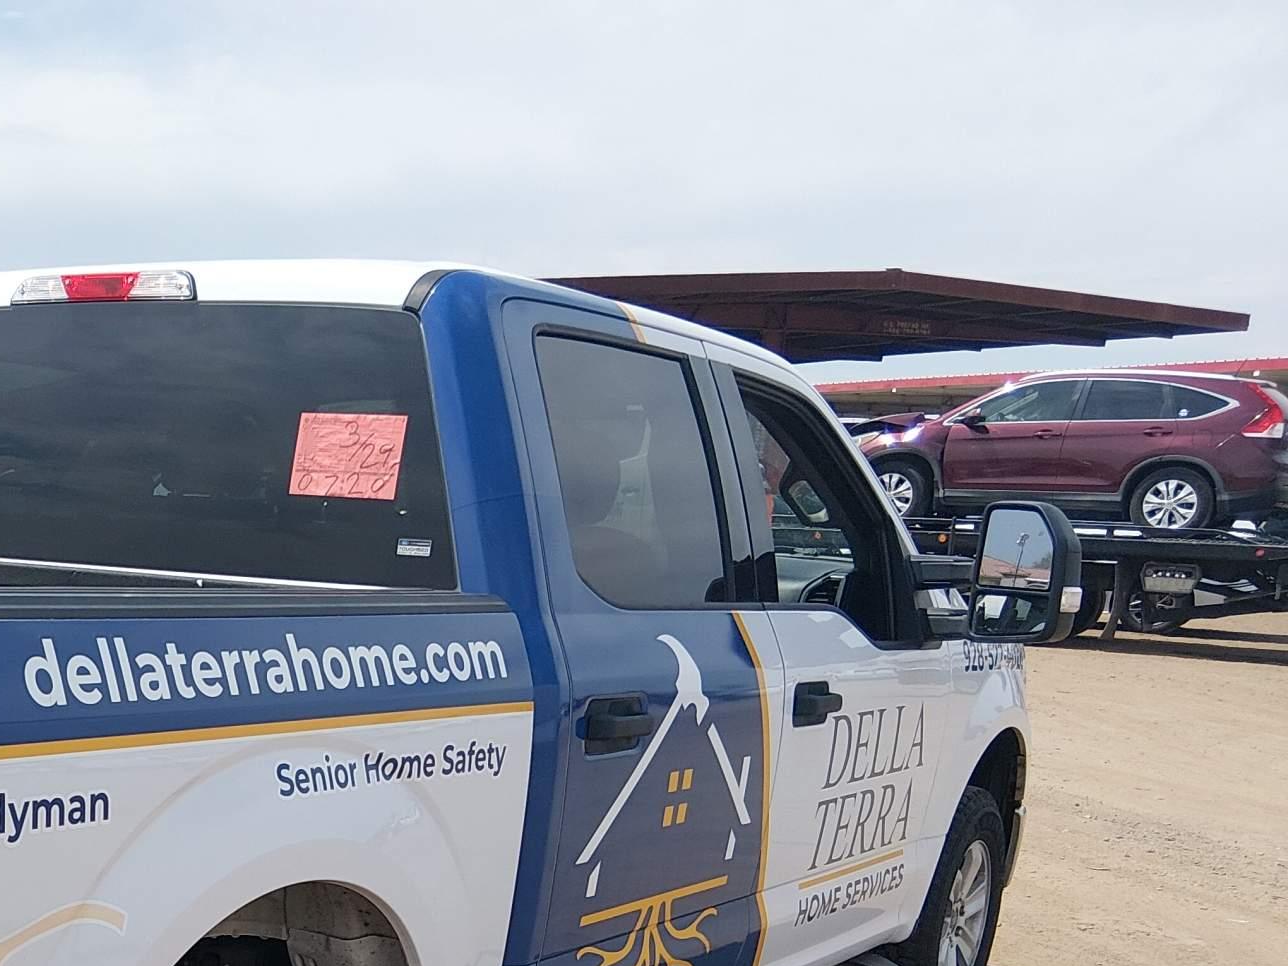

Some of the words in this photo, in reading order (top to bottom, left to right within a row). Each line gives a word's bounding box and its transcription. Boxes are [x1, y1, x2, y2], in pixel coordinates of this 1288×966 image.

[340, 421, 396, 469] 3/29
[24, 633, 508, 709] dellaterrahome.com
[276, 754, 357, 797] Senior
[364, 752, 436, 784] Home
[442, 741, 507, 776] Safety
[821, 701, 925, 790] DELLA
[807, 777, 913, 870] TERRA
[794, 886, 842, 927] HOME
[841, 863, 904, 909] SERVICES
